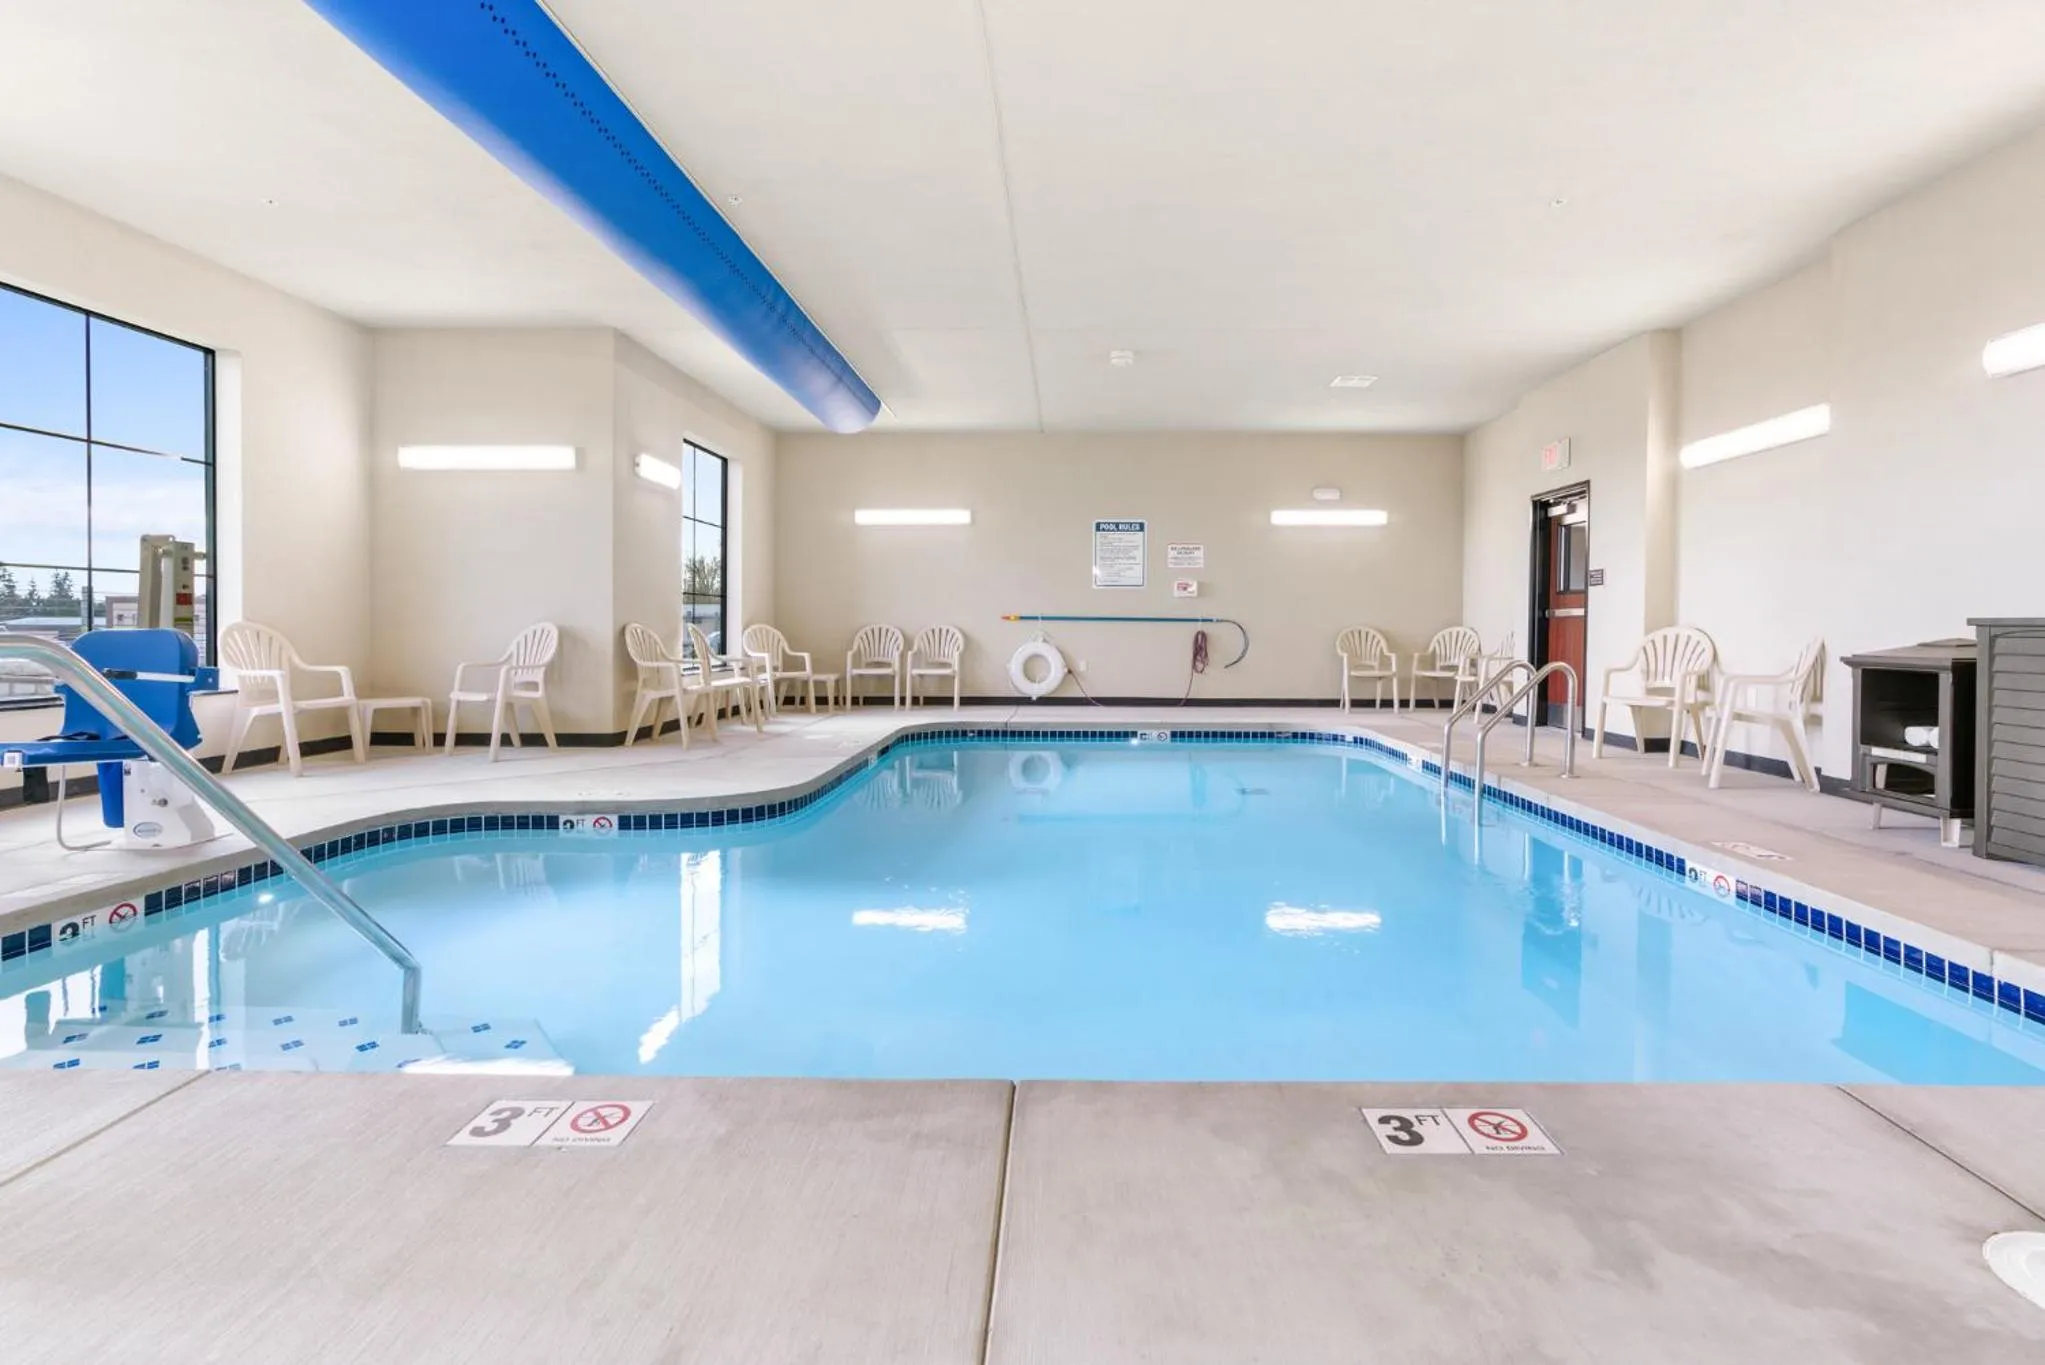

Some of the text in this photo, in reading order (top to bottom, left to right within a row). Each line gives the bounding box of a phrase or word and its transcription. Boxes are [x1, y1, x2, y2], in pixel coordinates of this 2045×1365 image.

[1099, 523, 1140, 531] POOL RULES
[468, 1106, 560, 1138] 3 FT
[1377, 1114, 1441, 1147] 3 FT
